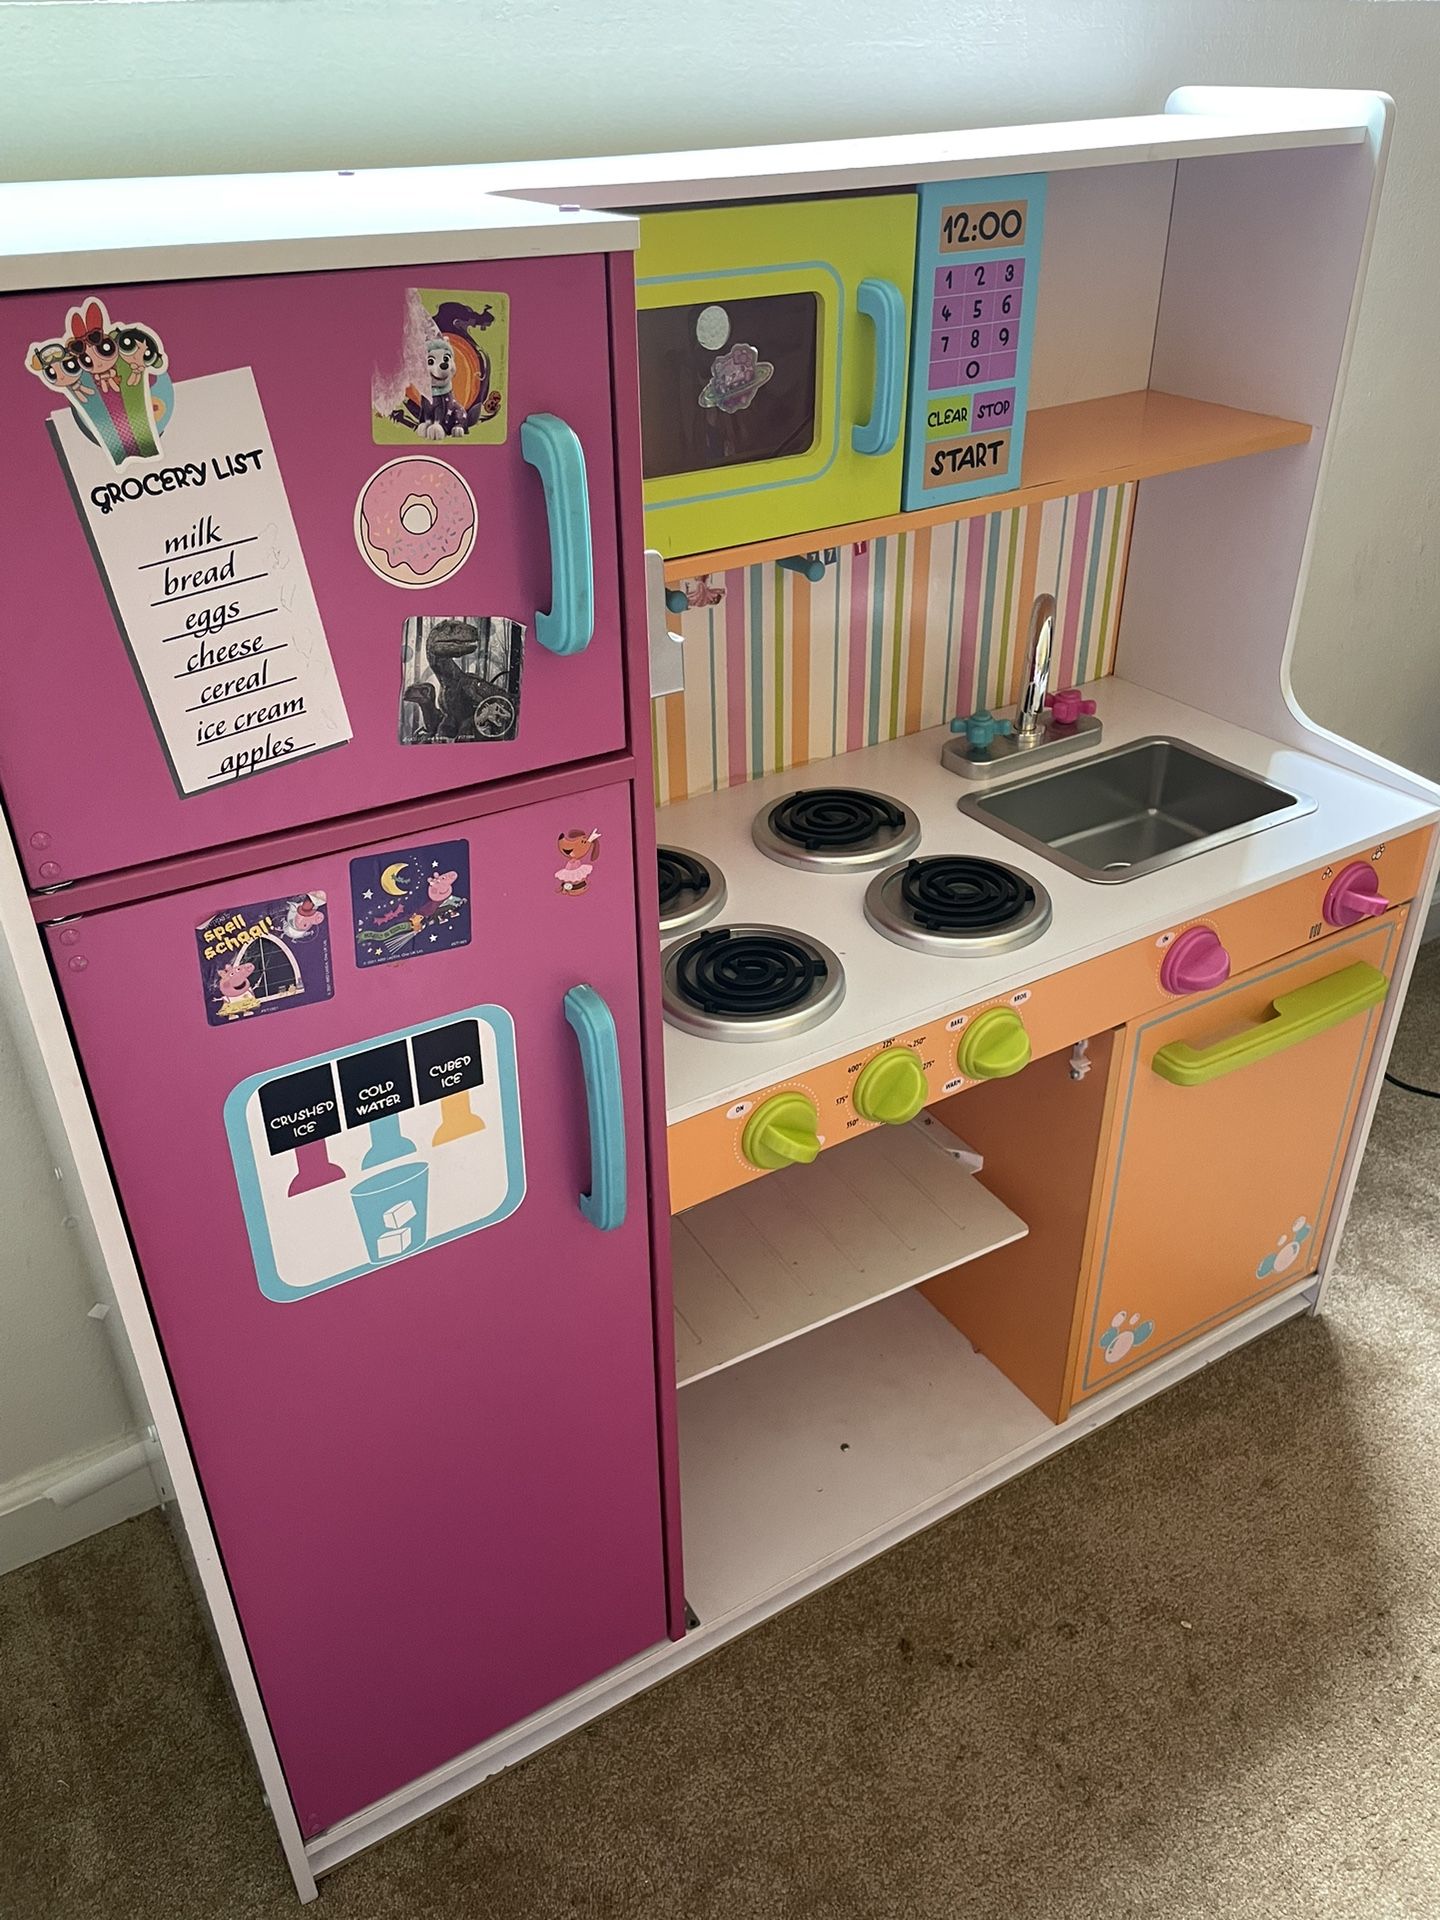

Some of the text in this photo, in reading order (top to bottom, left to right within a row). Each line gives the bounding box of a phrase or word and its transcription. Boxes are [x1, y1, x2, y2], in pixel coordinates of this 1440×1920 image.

[943, 209, 1022, 244] 12:00
[946, 264, 1014, 290] 1 2 3
[941, 295, 1012, 321] 4 5 6
[941, 328, 1009, 353] 7 8 9
[966, 360, 980, 379] 0
[927, 406, 968, 428] CLEAR
[977, 399, 1010, 419] STOP
[930, 439, 1004, 476] START
[90, 449, 263, 514] GROCERY LIST
[165, 515, 223, 554] milk
[164, 550, 235, 596] bread
[185, 601, 240, 638] eggs
[187, 635, 264, 672] cheese
[200, 658, 268, 703] cereal
[197, 696, 304, 742] ice cream
[220, 733, 295, 779] apples
[203, 913, 247, 943] spell
[429, 1055, 471, 1077] CUBED
[358, 1080, 395, 1101] COLD
[441, 1072, 463, 1088] ICE
[270, 1100, 334, 1129] CRUSHED
[356, 1094, 401, 1116] WATER
[735, 1104, 745, 1113] ON
[293, 1120, 317, 1138] ICE
